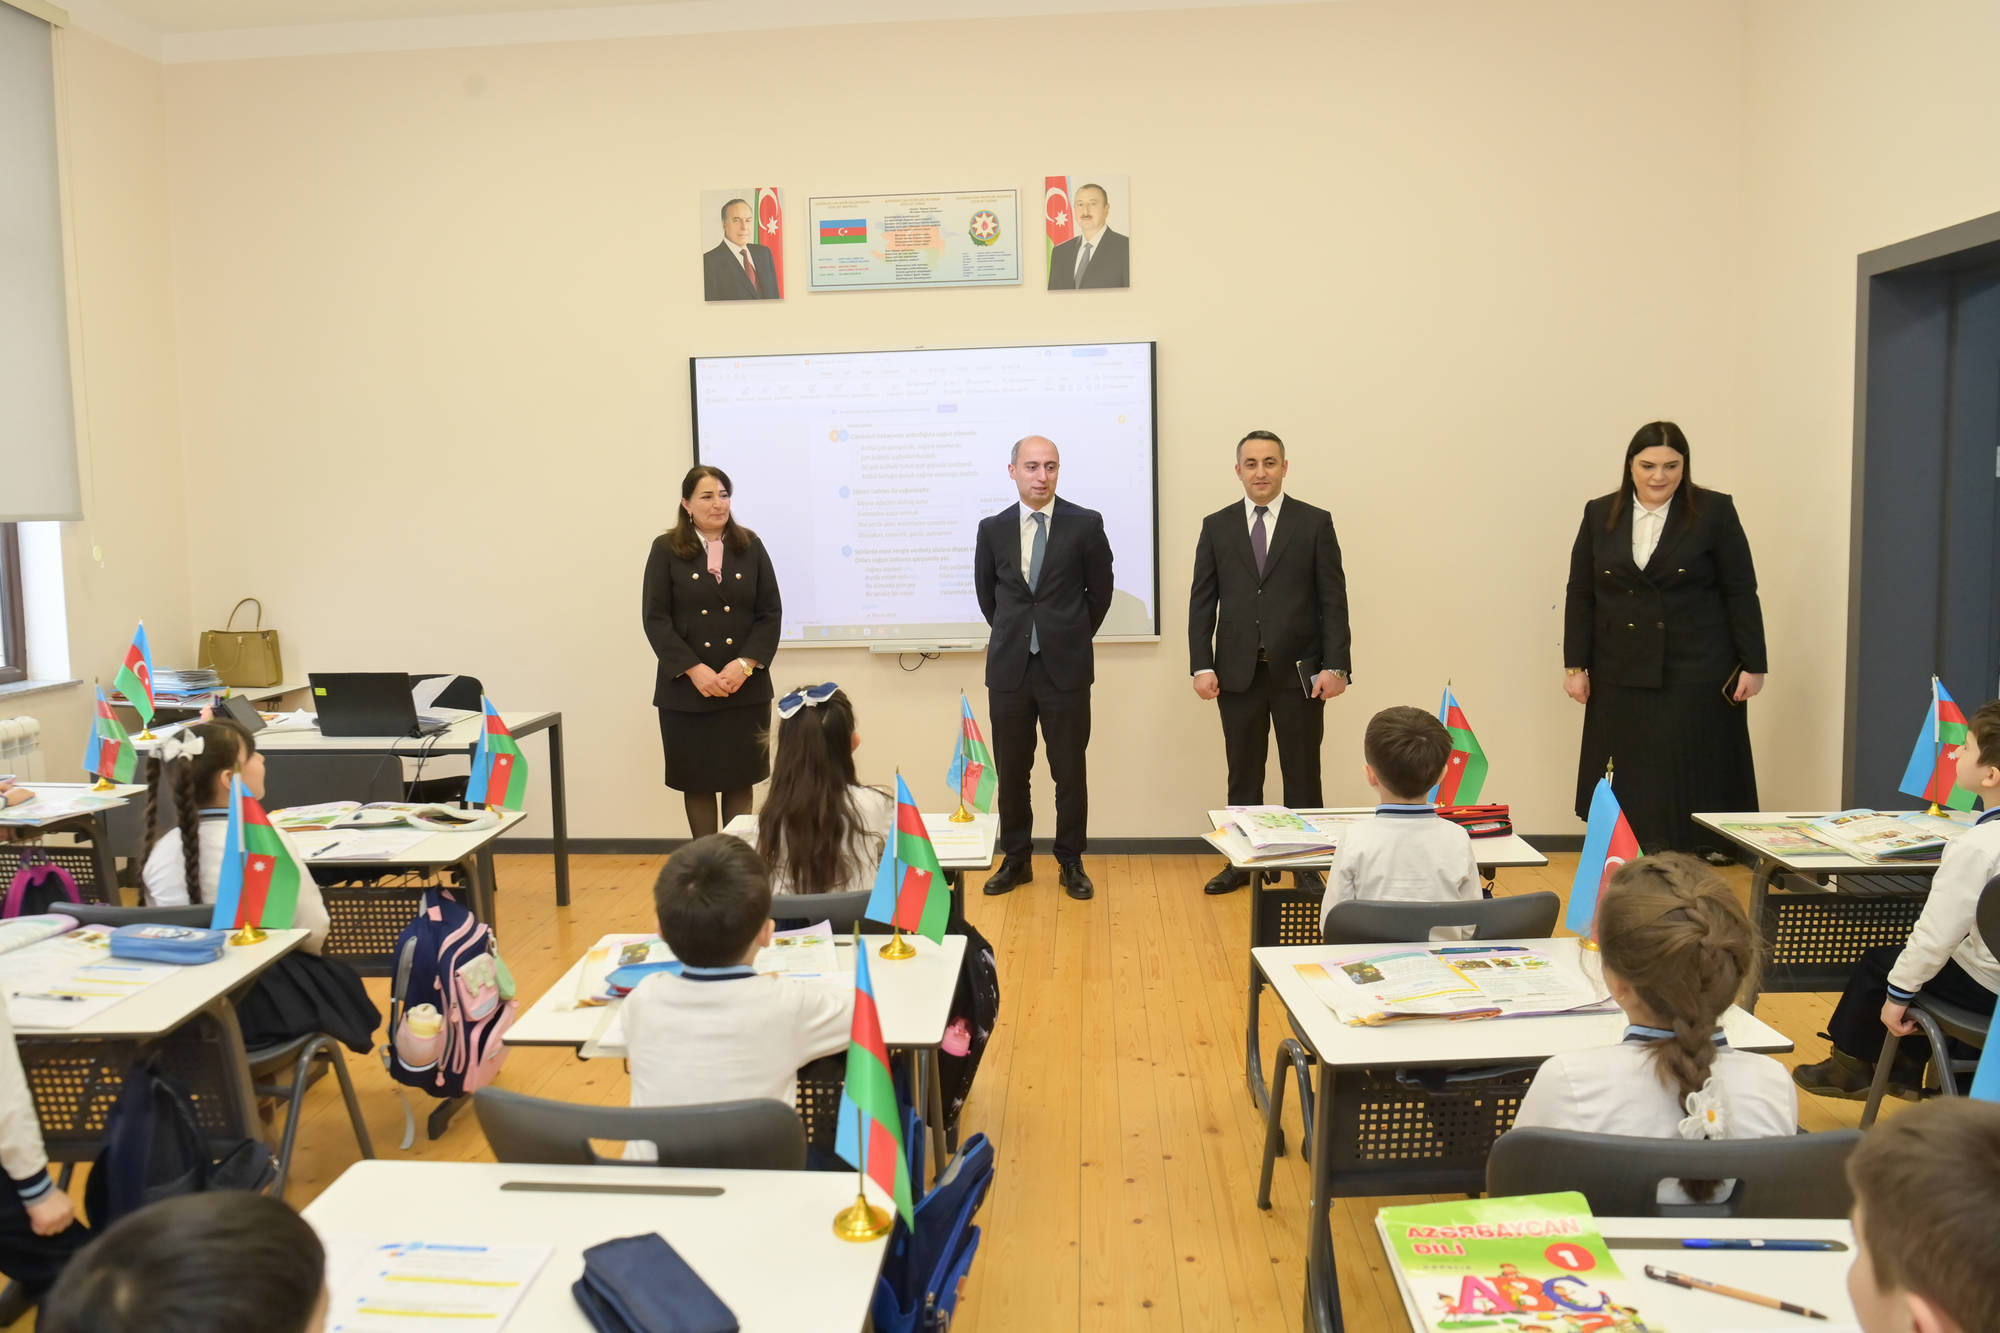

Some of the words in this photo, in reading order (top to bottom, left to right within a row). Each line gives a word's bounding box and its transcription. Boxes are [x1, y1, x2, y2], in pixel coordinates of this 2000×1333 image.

[1408, 1219, 1579, 1239] AZƏRBAYCAN
[1413, 1241, 1466, 1255] DİLİ
[1557, 1250, 1579, 1268] 1
[1456, 1275, 1606, 1314] ABC
